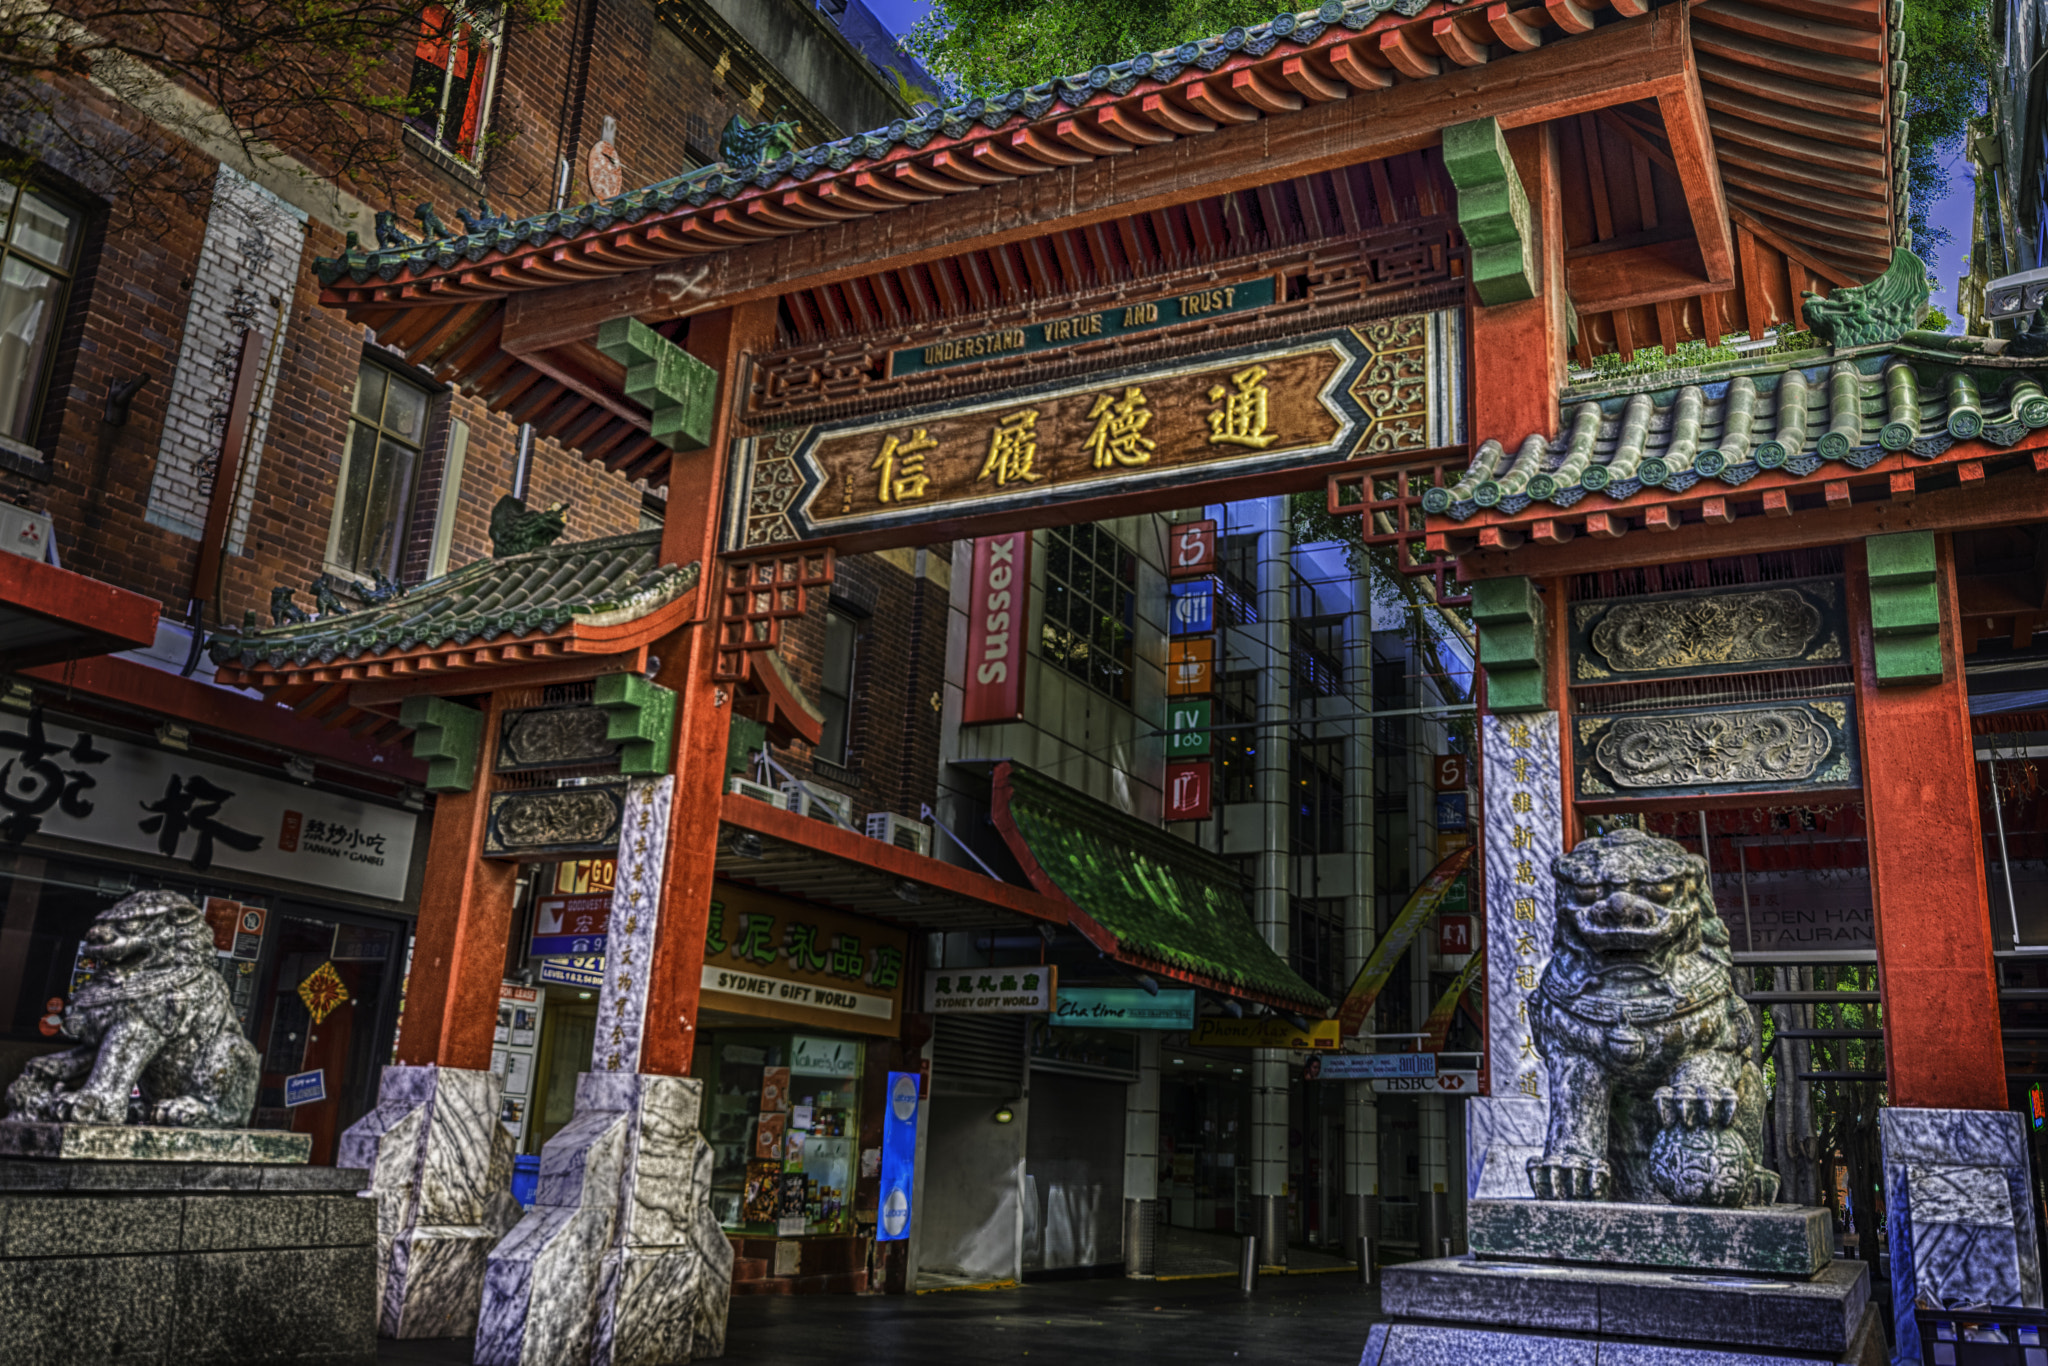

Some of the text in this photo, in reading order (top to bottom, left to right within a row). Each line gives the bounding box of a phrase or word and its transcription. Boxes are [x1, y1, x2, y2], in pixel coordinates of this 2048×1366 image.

[923, 287, 1236, 364] UNDERSTAND VIRTUE AND TRUST
[977, 537, 1014, 685] Sussex
[303, 841, 384, 866] TAIWAN GANBEI
[514, 988, 535, 1000] LEASE
[718, 972, 857, 1009] SYDNEY GIFT WORLD
[935, 996, 1039, 1008] SYDNEY GIFT WORLD
[1387, 1076, 1434, 1090] HSBC
